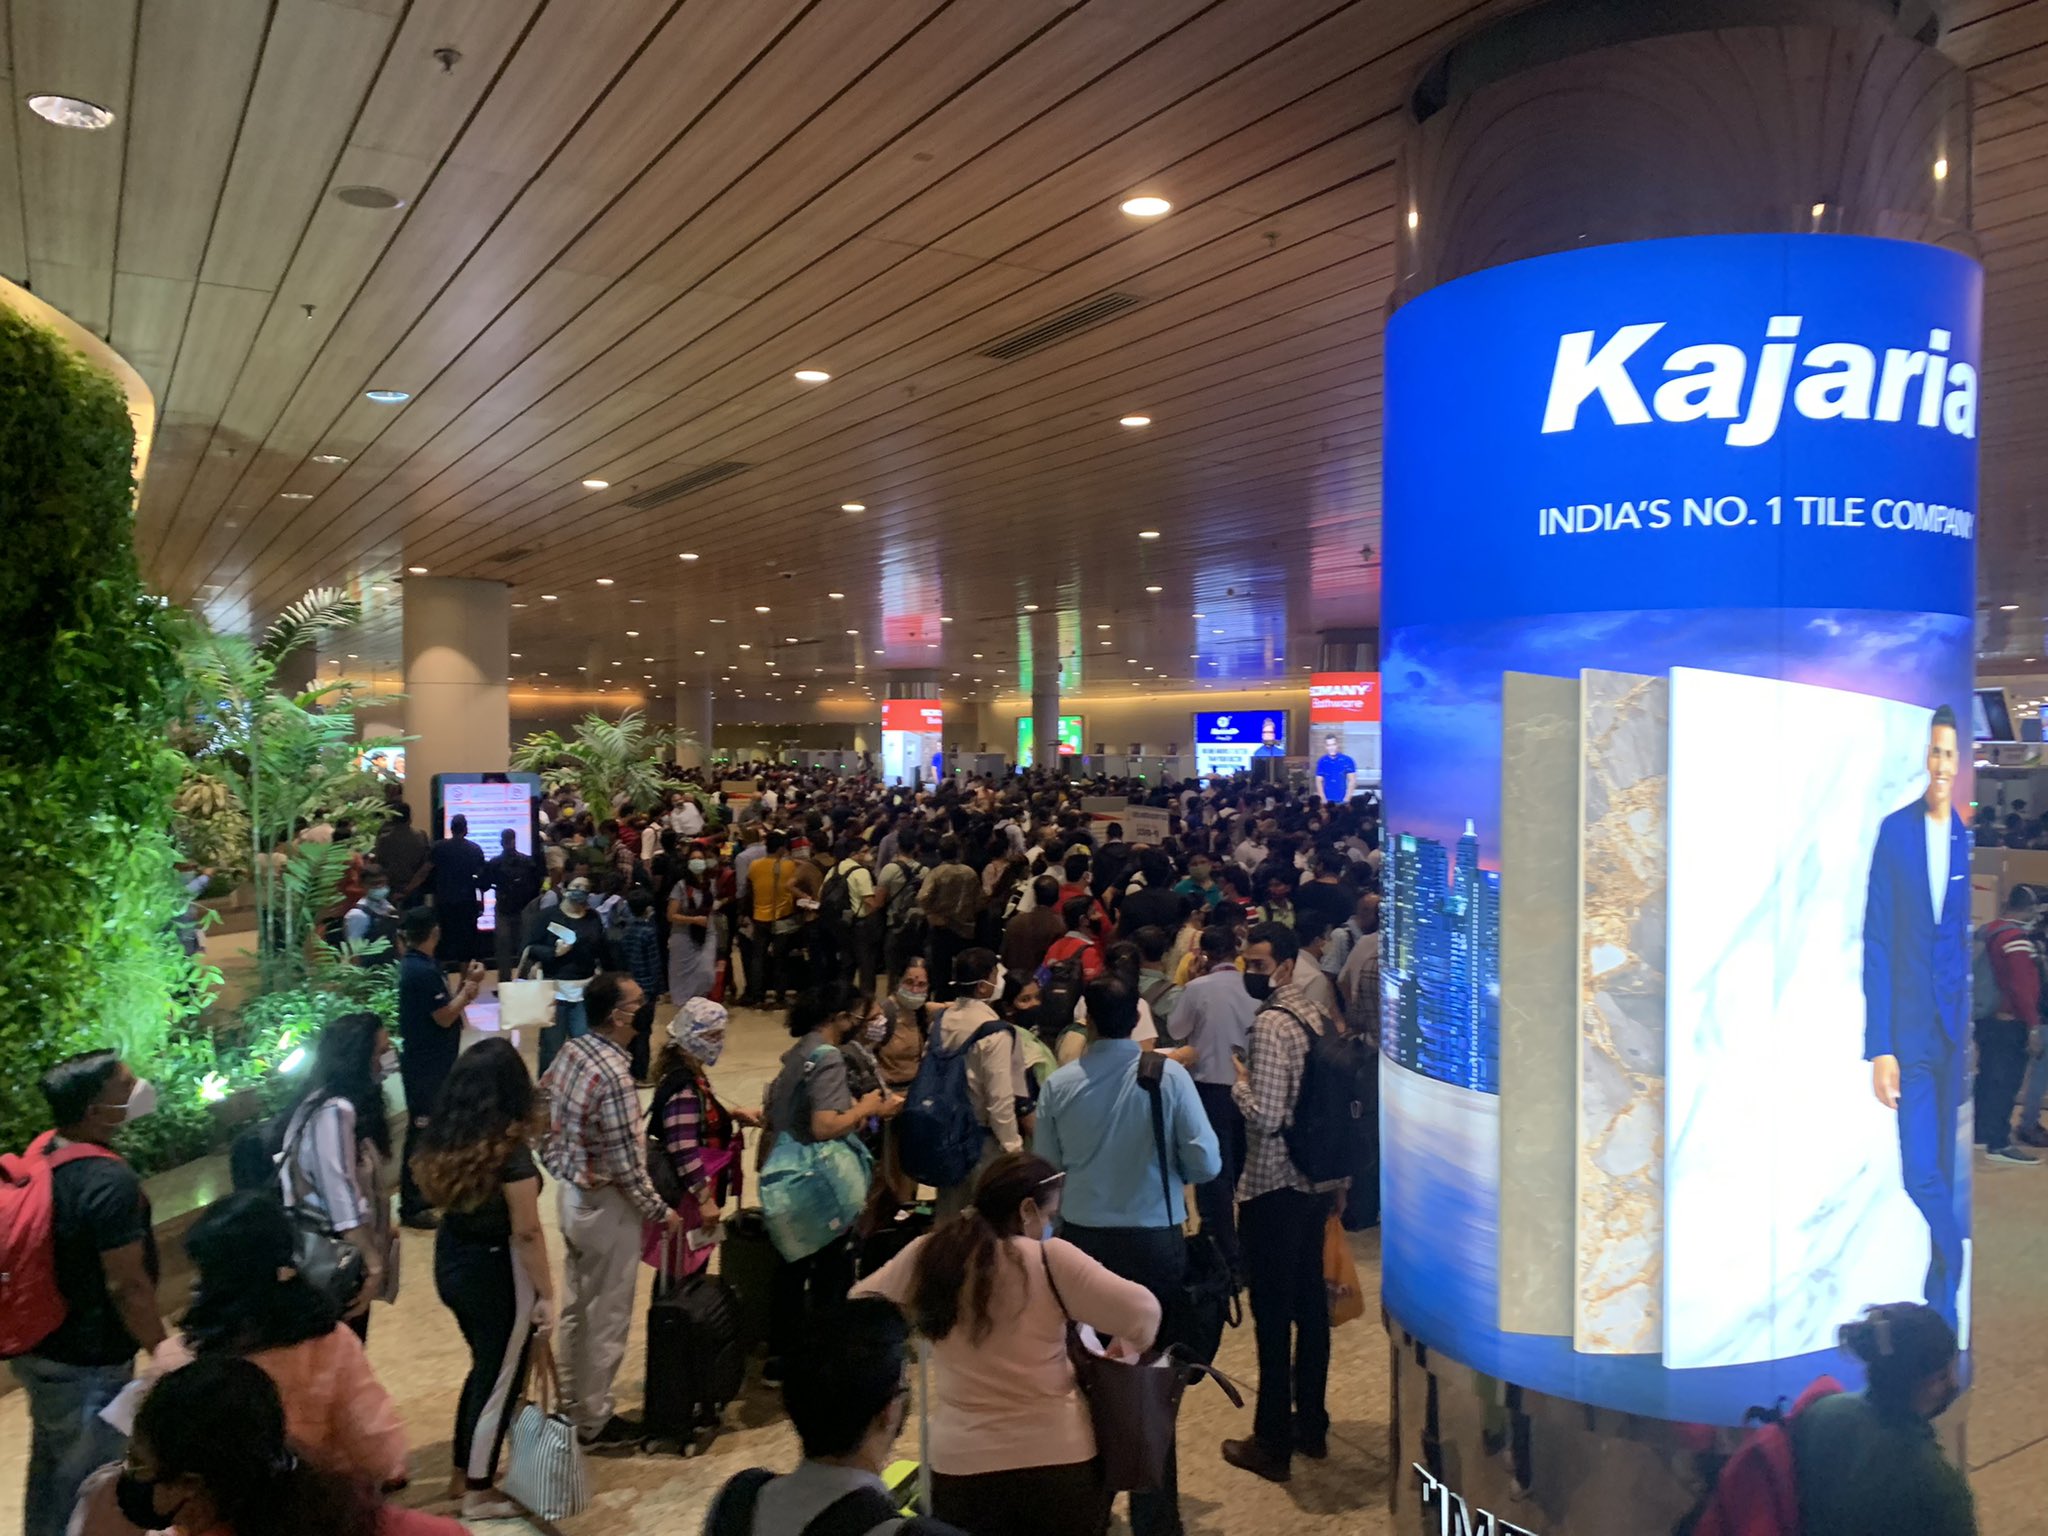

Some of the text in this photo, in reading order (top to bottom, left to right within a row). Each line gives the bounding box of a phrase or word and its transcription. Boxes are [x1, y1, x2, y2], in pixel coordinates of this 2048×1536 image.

[1541, 316, 1977, 447] Kajaria
[1539, 498, 1672, 536] INDIA'S
[1683, 496, 1758, 526] NO.
[1765, 496, 1781, 525] 1
[1793, 497, 1866, 527] TILE
